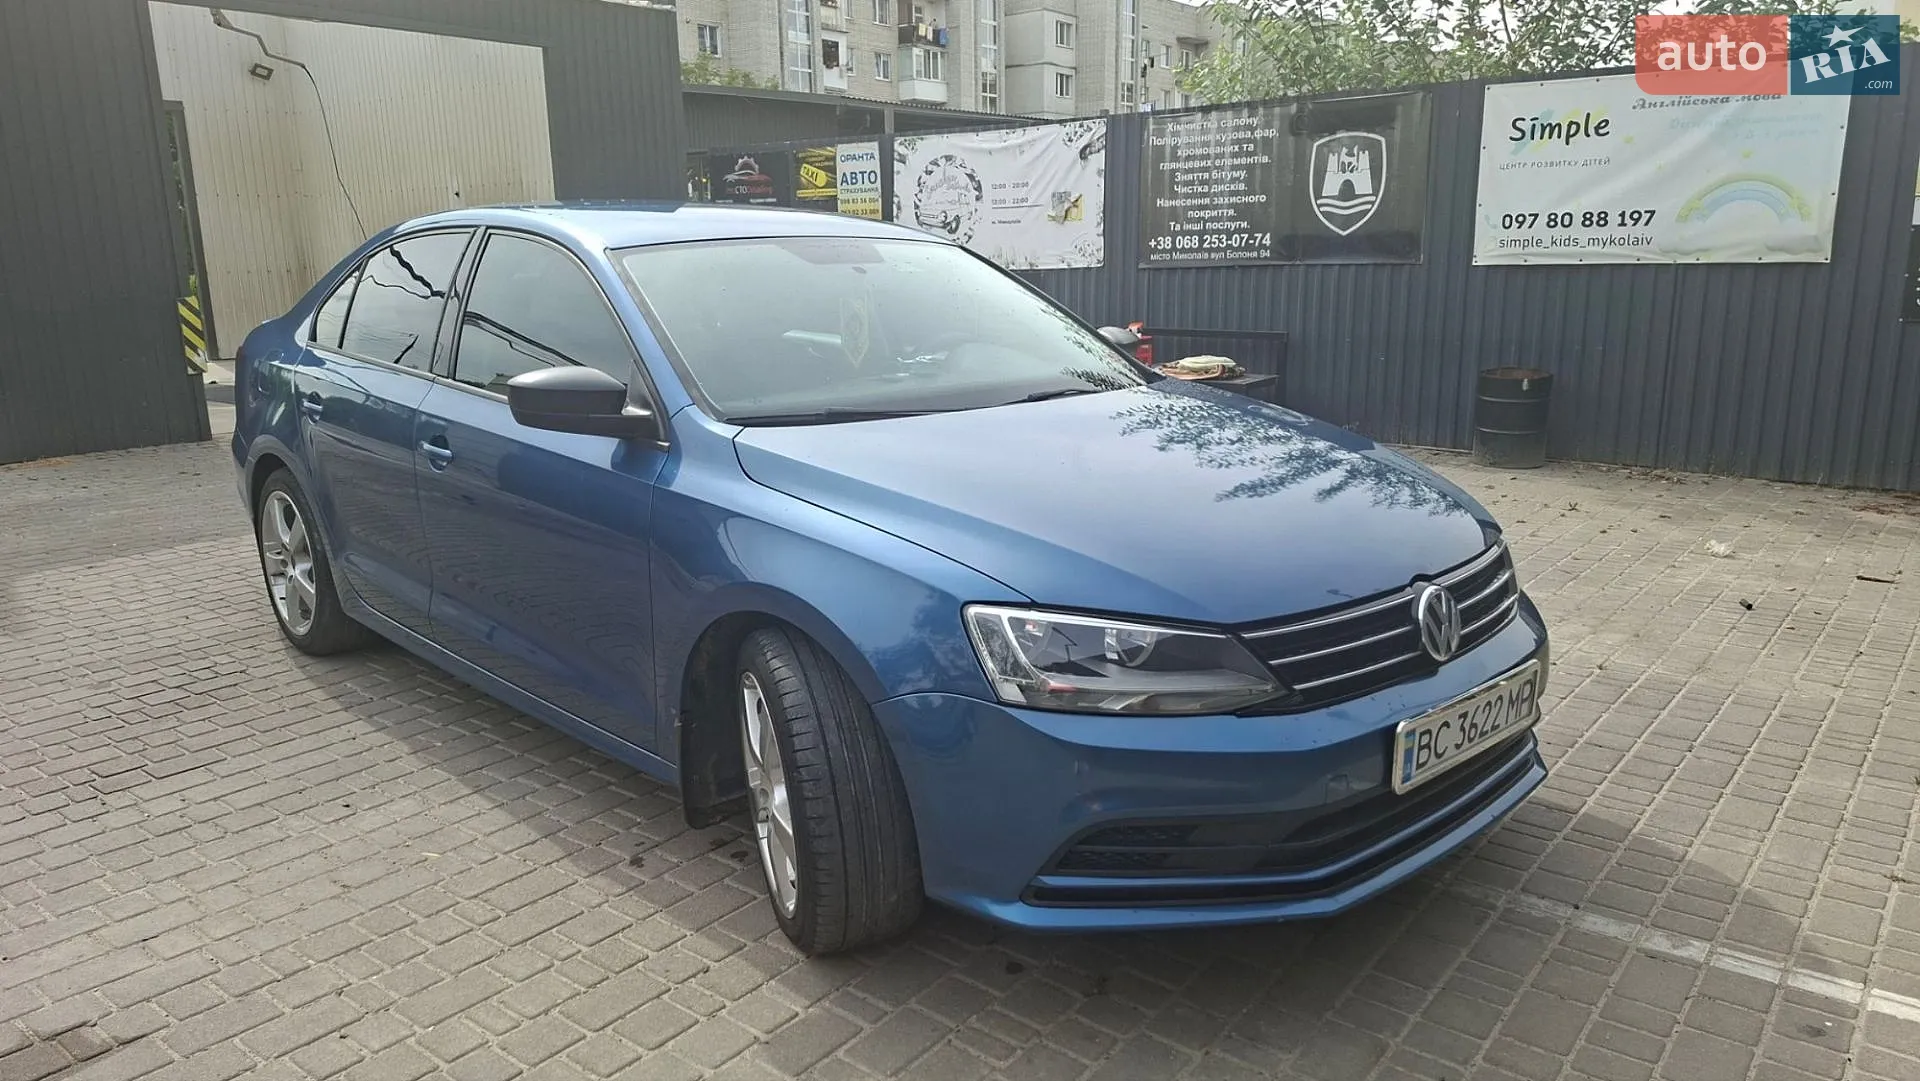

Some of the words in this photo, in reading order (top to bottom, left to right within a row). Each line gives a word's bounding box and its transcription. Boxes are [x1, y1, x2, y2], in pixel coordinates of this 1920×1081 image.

[1509, 112, 1611, 146] Simple
[840, 152, 876, 163] ОРАНТА
[1177, 144, 1239, 158] хромованих
[1242, 143, 1255, 152] та
[1160, 159, 1211, 170] глянцевих
[1215, 154, 1271, 166] елементів.
[1500, 161, 1528, 170] ЦЕНТР
[1531, 160, 1578, 169] РОЗВИТКУ
[1581, 158, 1611, 167] ДІТЕЙ
[802, 166, 818, 182] TAXI
[840, 170, 878, 186] АВТО
[1174, 172, 1209, 182] Зняття
[1211, 169, 1248, 180] бітуму.
[1174, 184, 1209, 193] Чистка
[1211, 181, 1248, 192] дисків.
[1156, 197, 1210, 207] Нанесення
[1213, 194, 1267, 204] захисного
[1188, 208, 1237, 220] покриття.
[1502, 213, 1540, 229] 097
[1546, 212, 1574, 228] 80
[1581, 211, 1609, 228] 88
[1617, 210, 1657, 227] 197
[1169, 221, 1181, 231] Та
[1183, 220, 1203, 230] інші
[1206, 220, 1251, 231] послуги.
[1149, 236, 1172, 249] +38
[1175, 235, 1199, 248] 068
[1203, 233, 1271, 248] 253-07-74
[1499, 234, 1654, 250] simple_kids_mykolaiv
[1150, 252, 1170, 260] місто
[1260, 249, 1271, 258] 94
[1415, 720, 1450, 771] BC
[1454, 694, 1504, 750] 3622
[1505, 678, 1534, 725] MP
